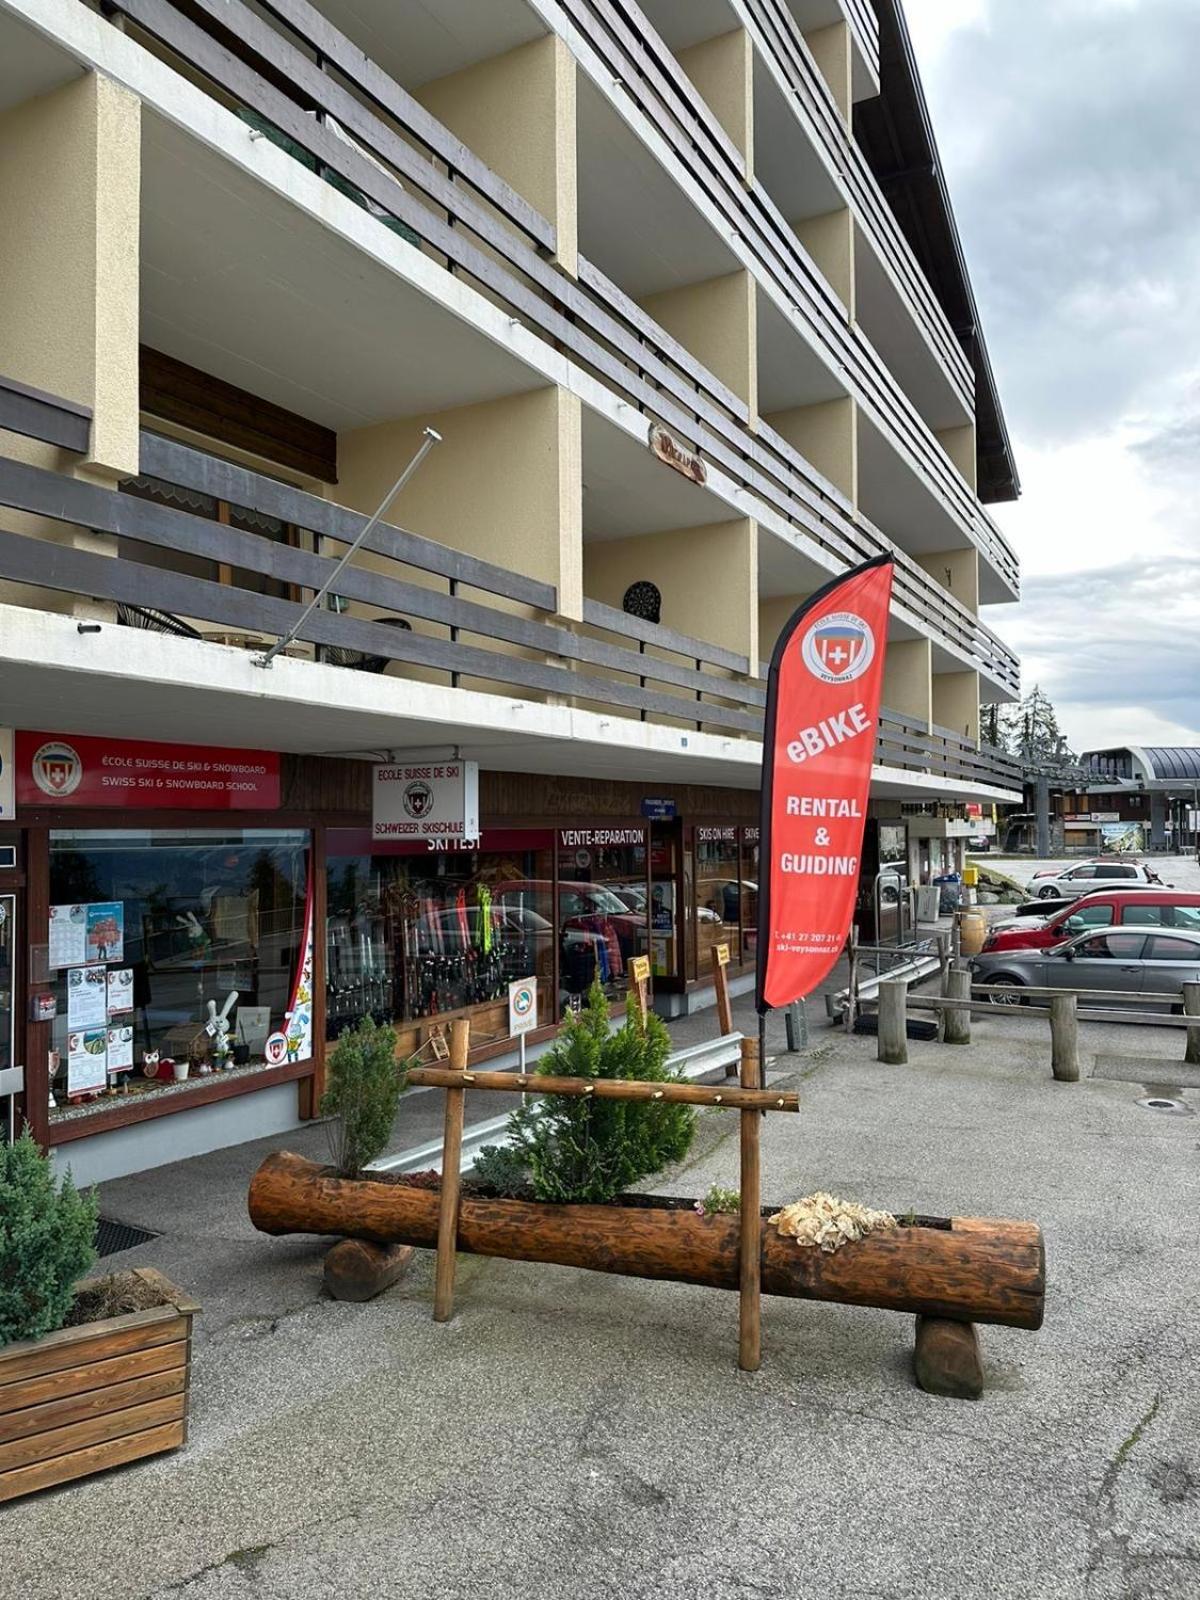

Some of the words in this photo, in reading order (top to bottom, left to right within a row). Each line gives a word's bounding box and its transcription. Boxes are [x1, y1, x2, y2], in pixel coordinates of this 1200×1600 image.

[786, 703, 871, 764] eBIKE
[135, 758, 170, 769] SUISSE
[172, 760, 185, 770] DE
[187, 762, 202, 770] SKI
[203, 762, 211, 771] &
[212, 763, 266, 775] SNOWBOARD
[379, 769, 402, 781] ECOLE
[405, 767, 431, 780] SUISSE
[434, 767, 444, 778] DE
[446, 766, 460, 777] SKI
[102, 776, 136, 787] SWISS
[138, 778, 154, 787] SKI
[156, 779, 164, 788] &
[166, 779, 224, 790] SNOWBOARD
[226, 782, 258, 792] SCHOOL
[786, 796, 861, 818] RENTAL
[375, 823, 418, 834] SCHWEIZER
[422, 821, 464, 833] SKISCHULE
[561, 829, 645, 846] VENTE-REPARATION
[814, 827, 829, 846] &
[781, 853, 857, 876] GUIDING
